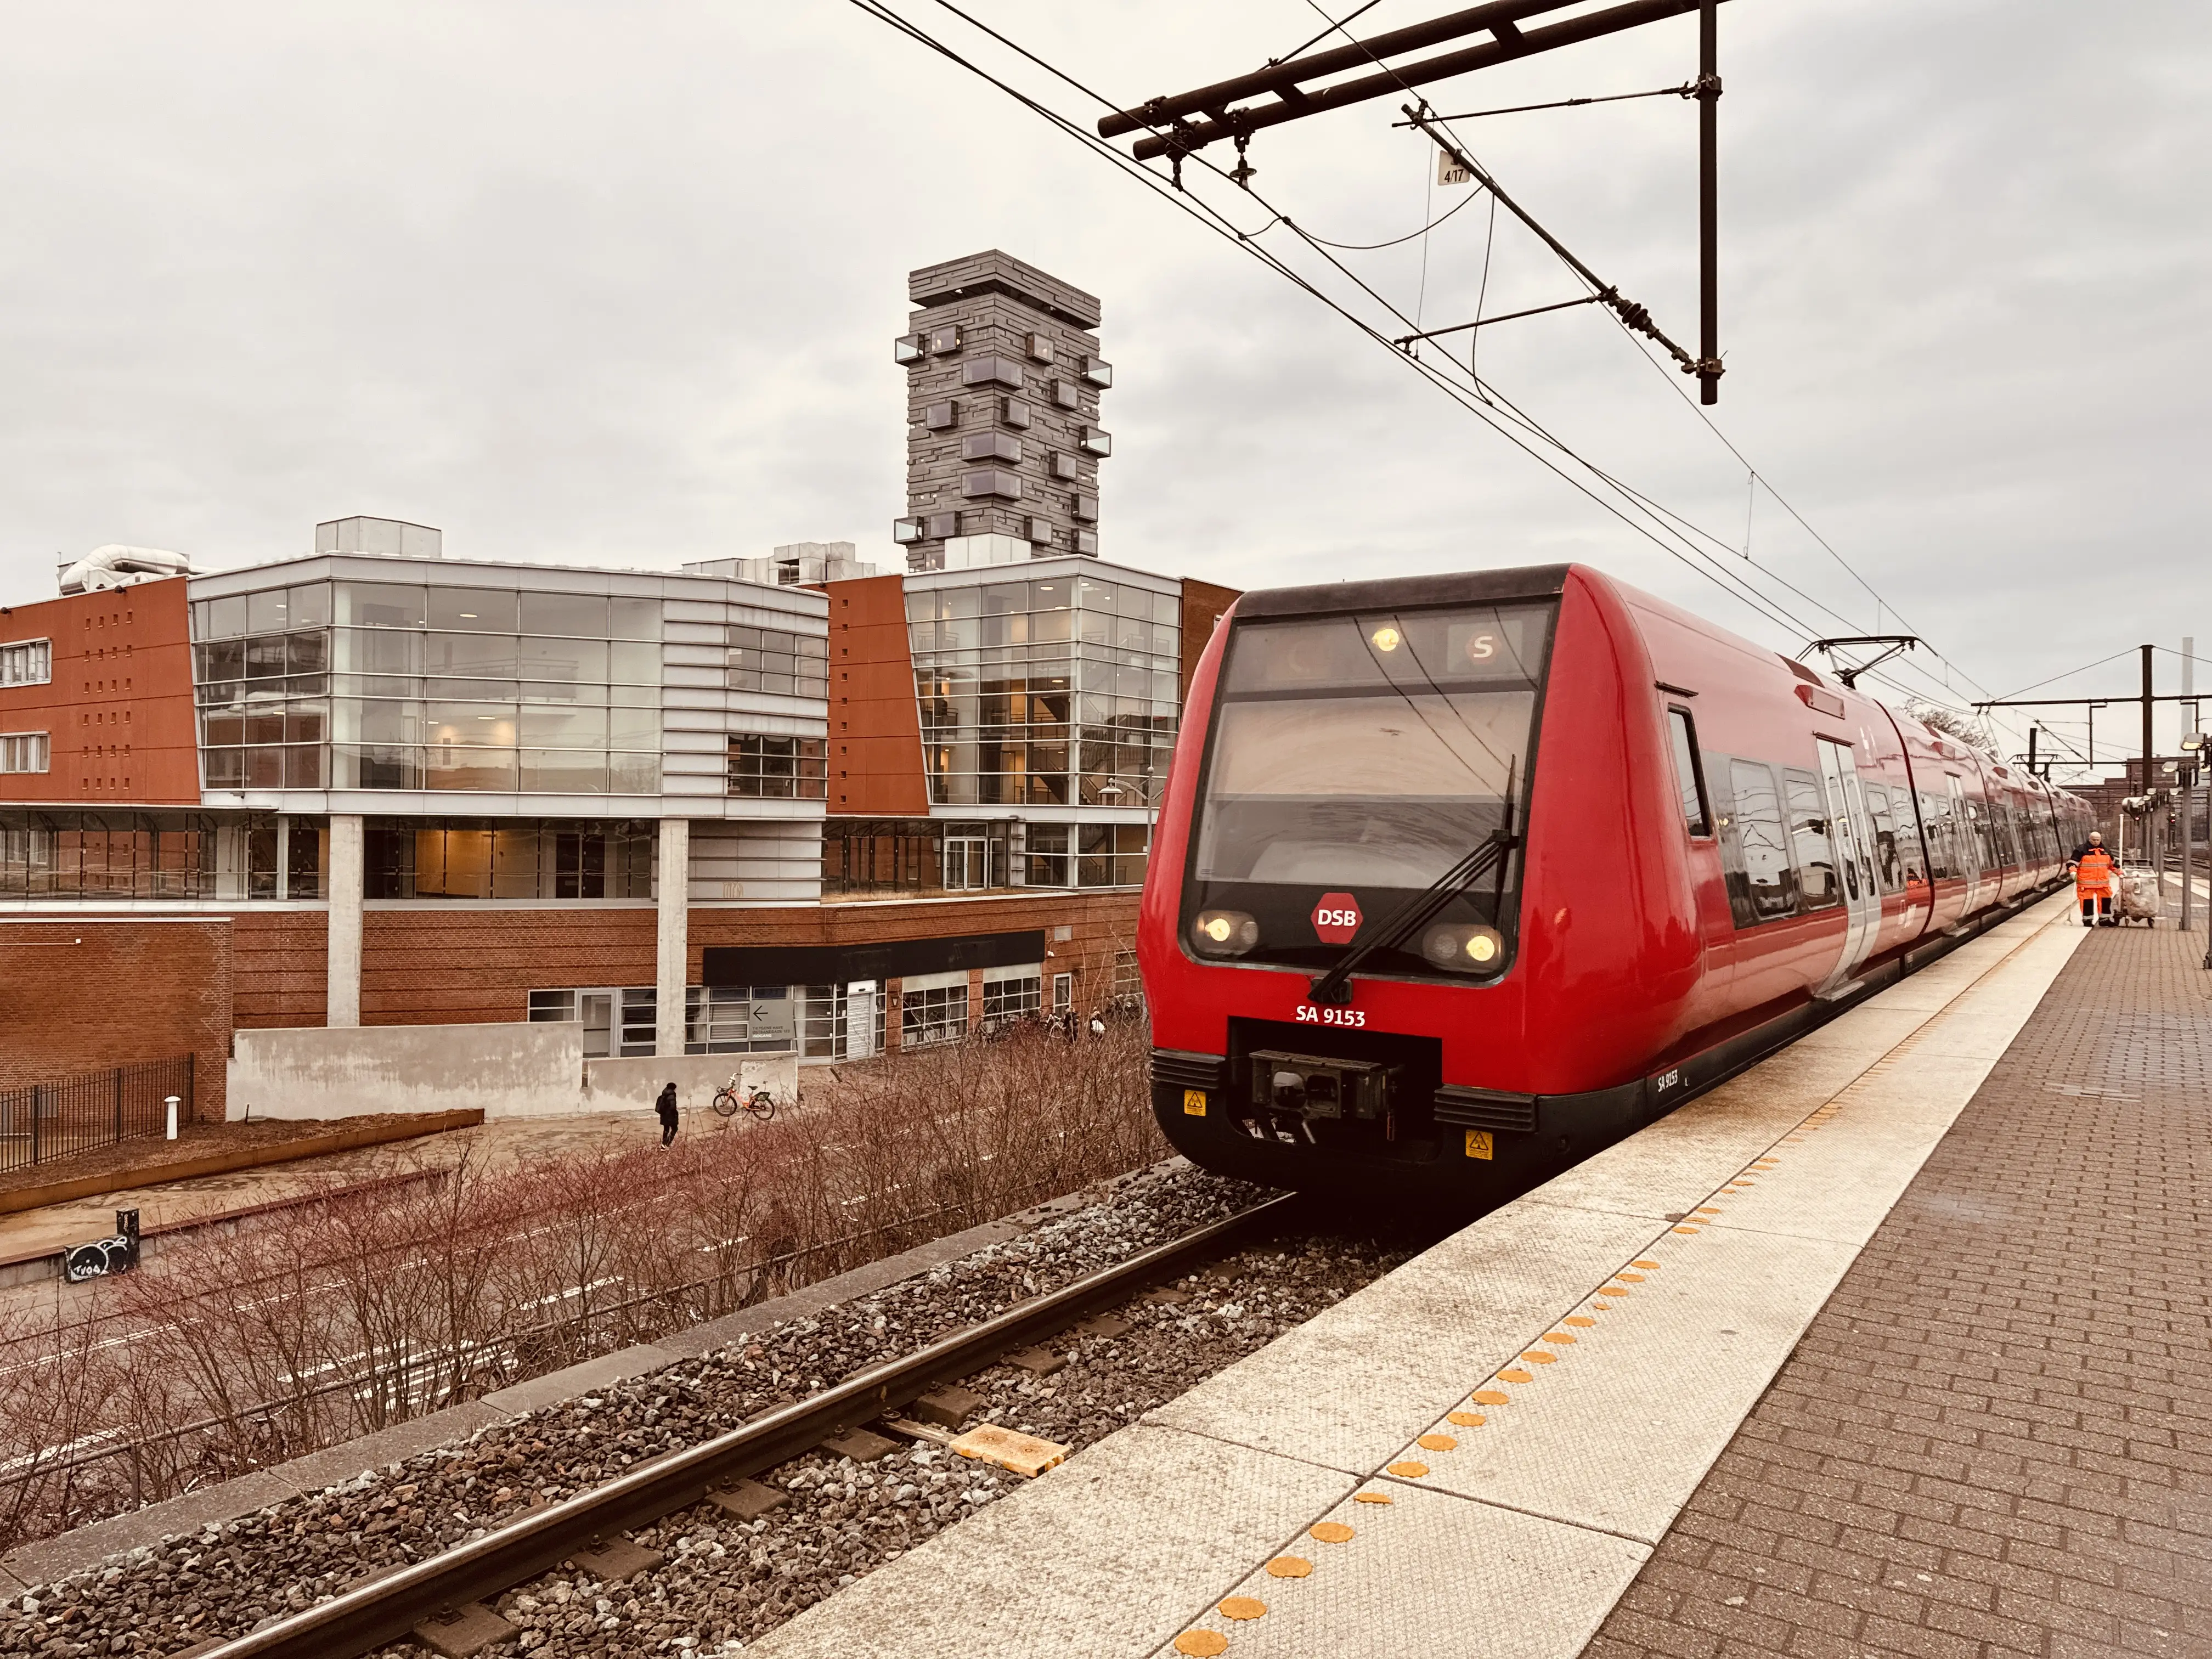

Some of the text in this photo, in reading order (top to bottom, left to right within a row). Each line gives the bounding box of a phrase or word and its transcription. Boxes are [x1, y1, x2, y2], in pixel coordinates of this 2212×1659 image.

[1444, 168, 1464, 183] 4/17
[1473, 636, 1493, 658] S
[1318, 909, 1356, 926] DSB
[1295, 1005, 1365, 1027] SA 9153
[1658, 1069, 1678, 1092] SA 9153
